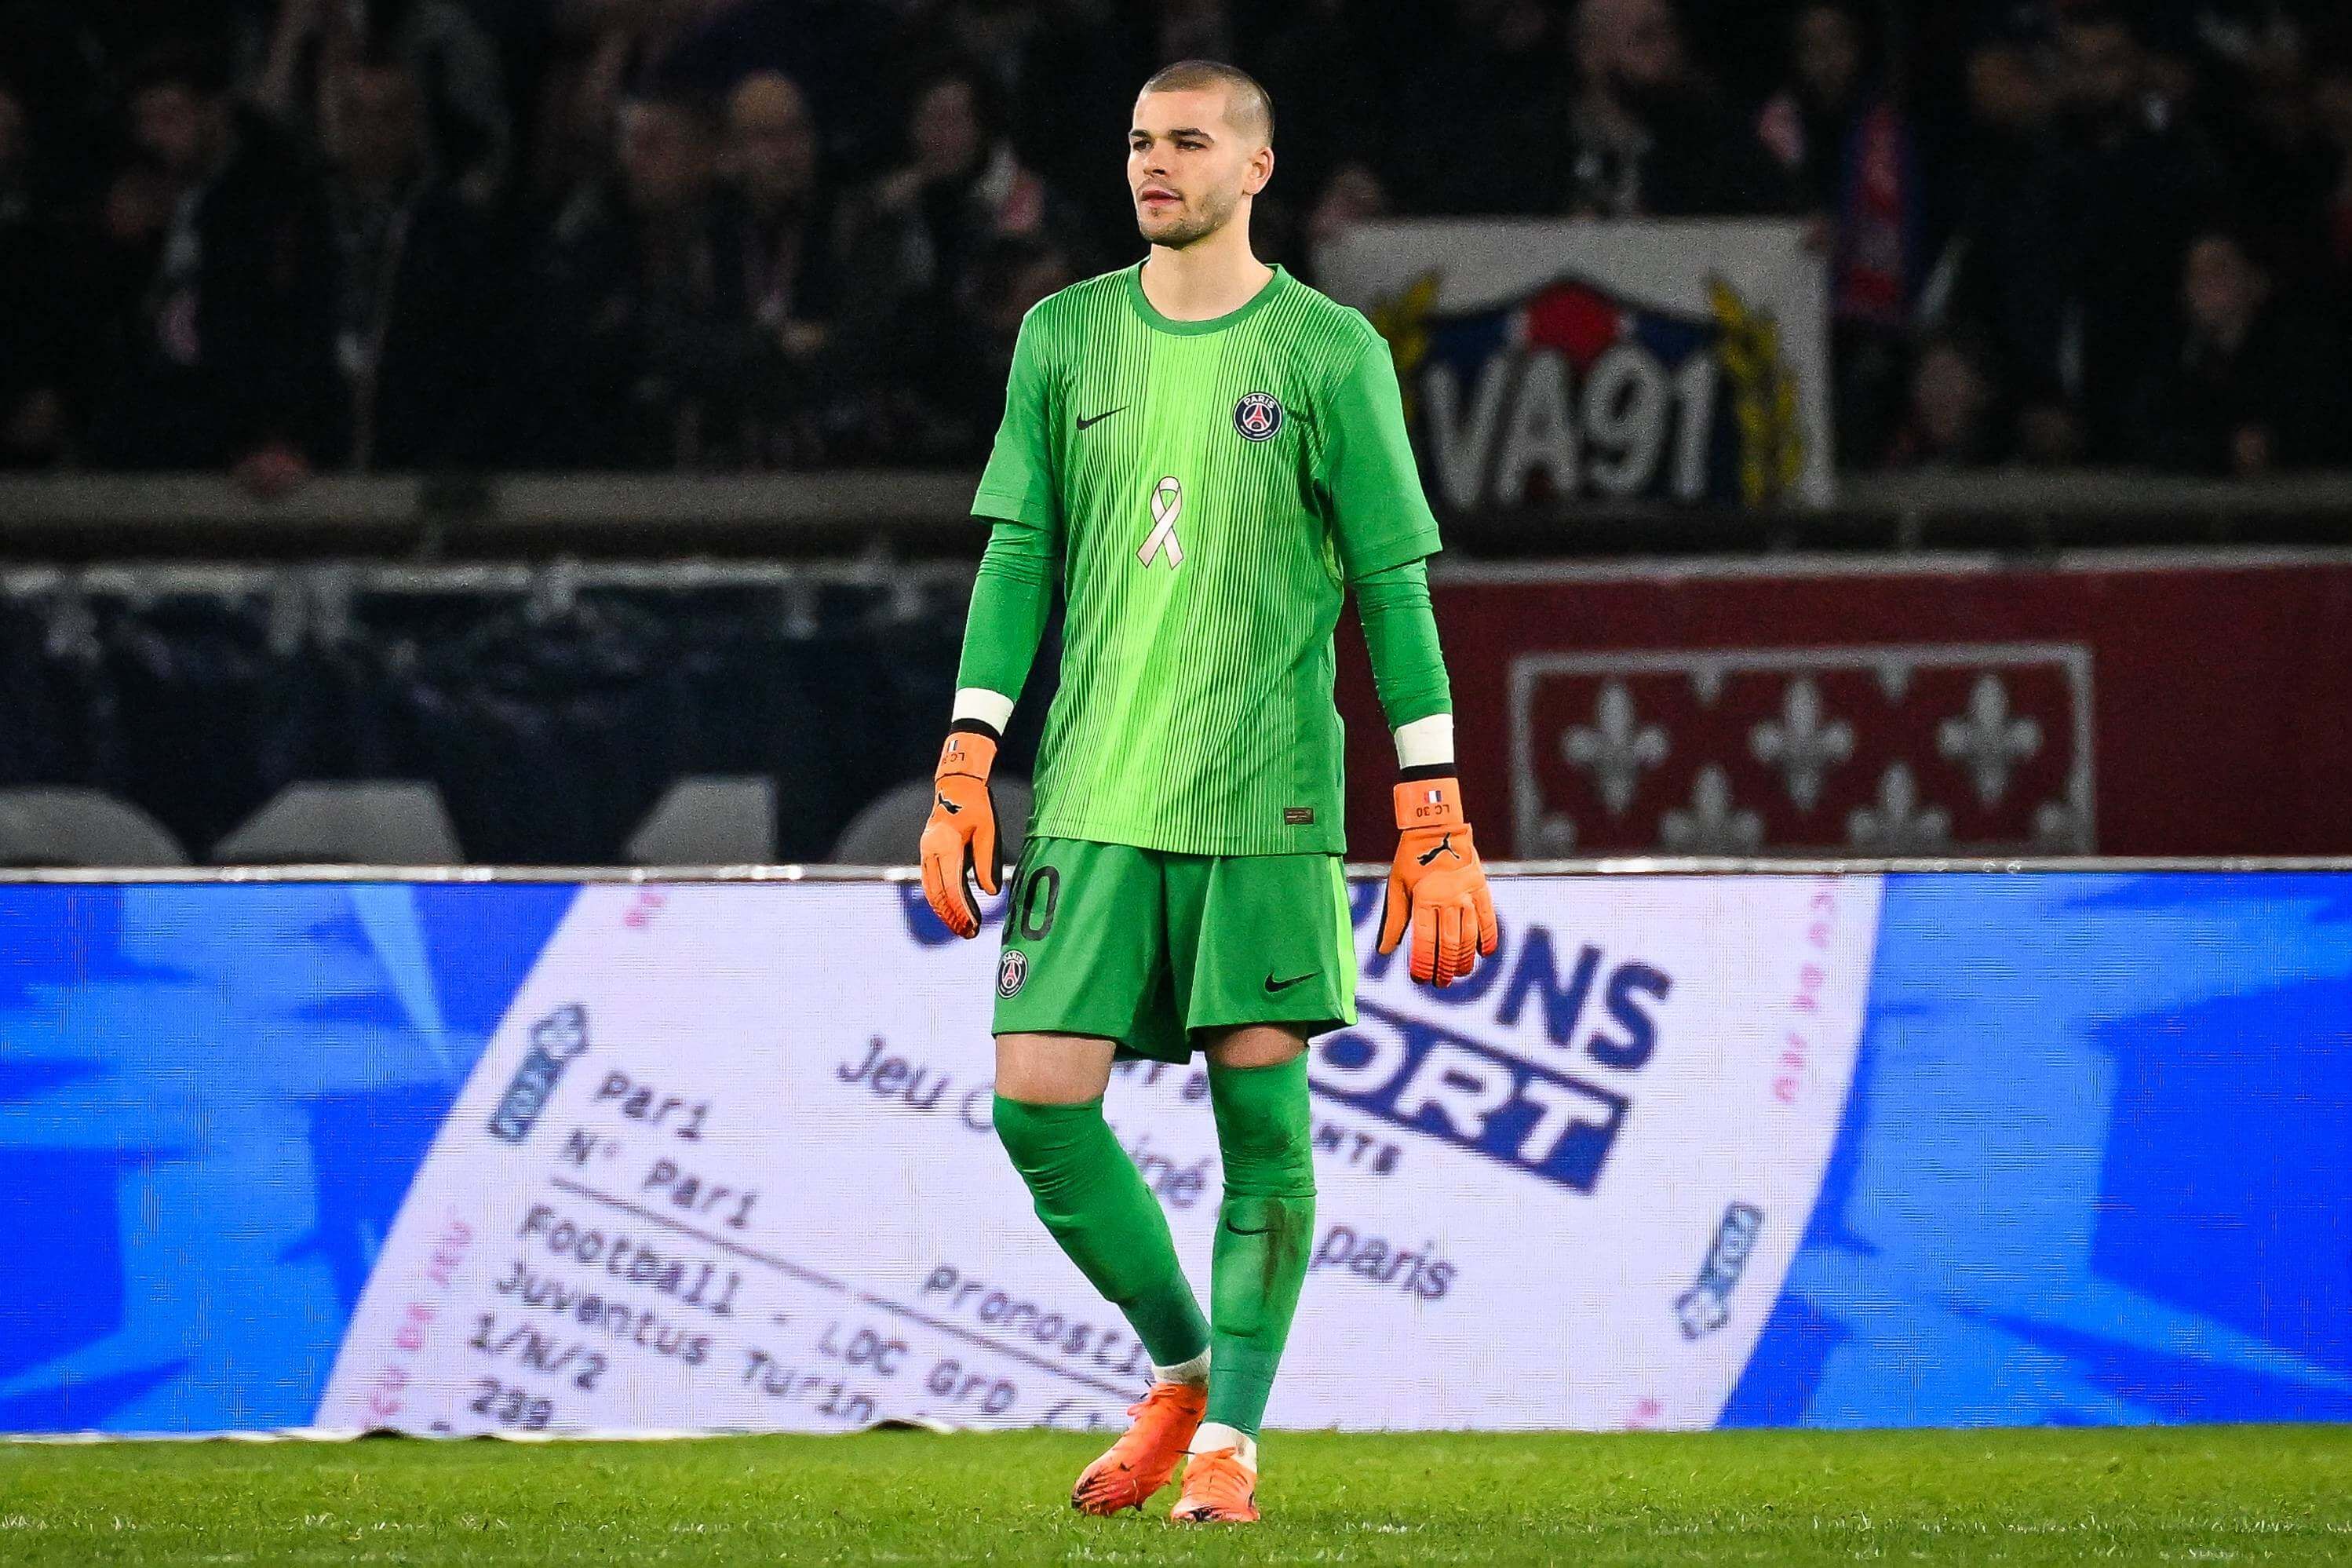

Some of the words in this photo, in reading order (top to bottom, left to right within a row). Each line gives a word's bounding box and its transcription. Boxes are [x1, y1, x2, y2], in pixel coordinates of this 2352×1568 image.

[1244, 395, 1275, 408] PARIS
[1421, 344, 1720, 510] VA91
[1416, 805, 1431, 818] 30
[1434, 804, 1450, 815] LC
[1307, 1025, 1612, 1165] ORT
[837, 1034, 952, 1113] Jeu
[1309, 1224, 1457, 1300] paris
[496, 1259, 711, 1366] Juventus
[518, 1204, 744, 1318] Football
[922, 1264, 1154, 1375] Pronosti
